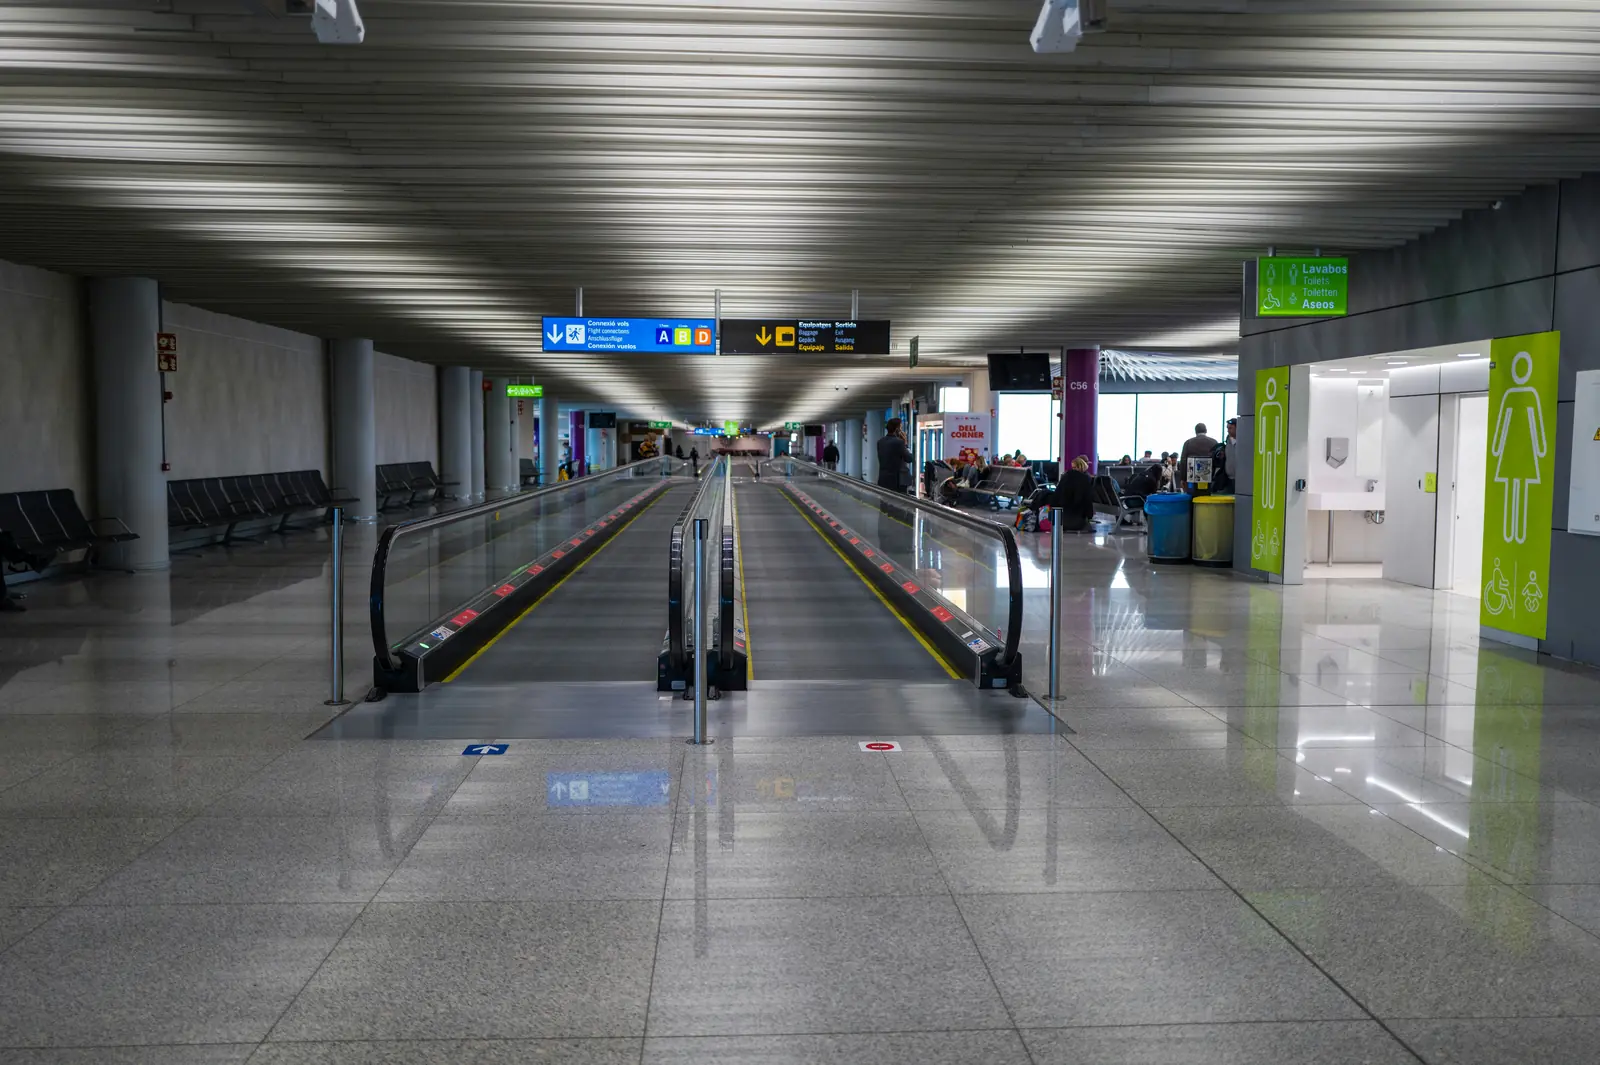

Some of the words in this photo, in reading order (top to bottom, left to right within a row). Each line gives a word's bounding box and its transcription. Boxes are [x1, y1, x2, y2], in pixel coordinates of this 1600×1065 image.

[1302, 263, 1347, 274] Lavabos
[1303, 276, 1330, 285] Toilets
[1303, 288, 1338, 297] Toiletten
[1302, 299, 1335, 309] Aseos
[659, 331, 669, 342] A
[679, 330, 688, 343] B
[699, 331, 709, 343] D
[1070, 381, 1088, 390] C56
